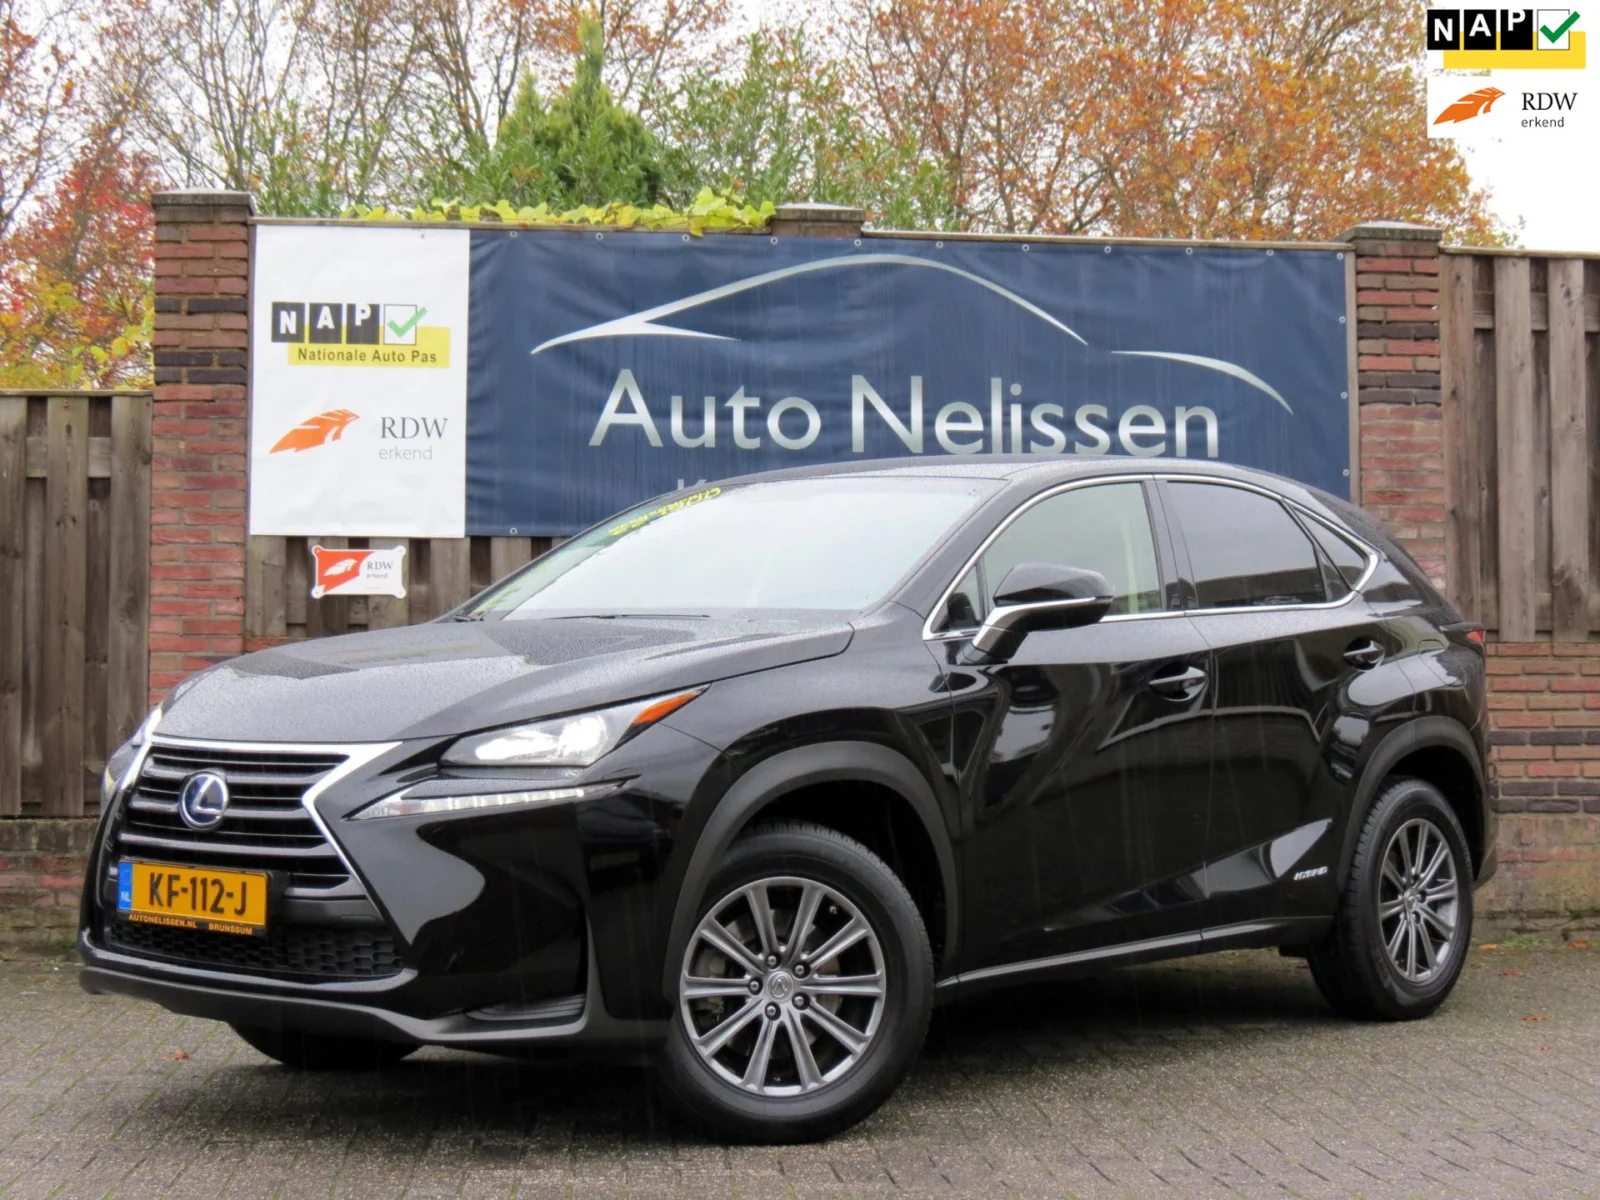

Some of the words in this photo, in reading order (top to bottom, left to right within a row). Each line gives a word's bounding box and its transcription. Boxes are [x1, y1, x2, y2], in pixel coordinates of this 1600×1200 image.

[279, 304, 372, 335] NAP
[298, 347, 367, 362] Nationale
[371, 349, 406, 363] Auto
[411, 350, 437, 363] Pas
[588, 368, 822, 450] Auto
[851, 374, 1220, 458] Nelissen
[380, 416, 449, 440] RDW
[379, 445, 433, 461] erkend
[367, 560, 394, 571] RDW
[148, 871, 248, 917] KF-112-J
[128, 913, 198, 929] AUTONELISSEN.NL
[208, 922, 253, 936] BRUNSSUM
